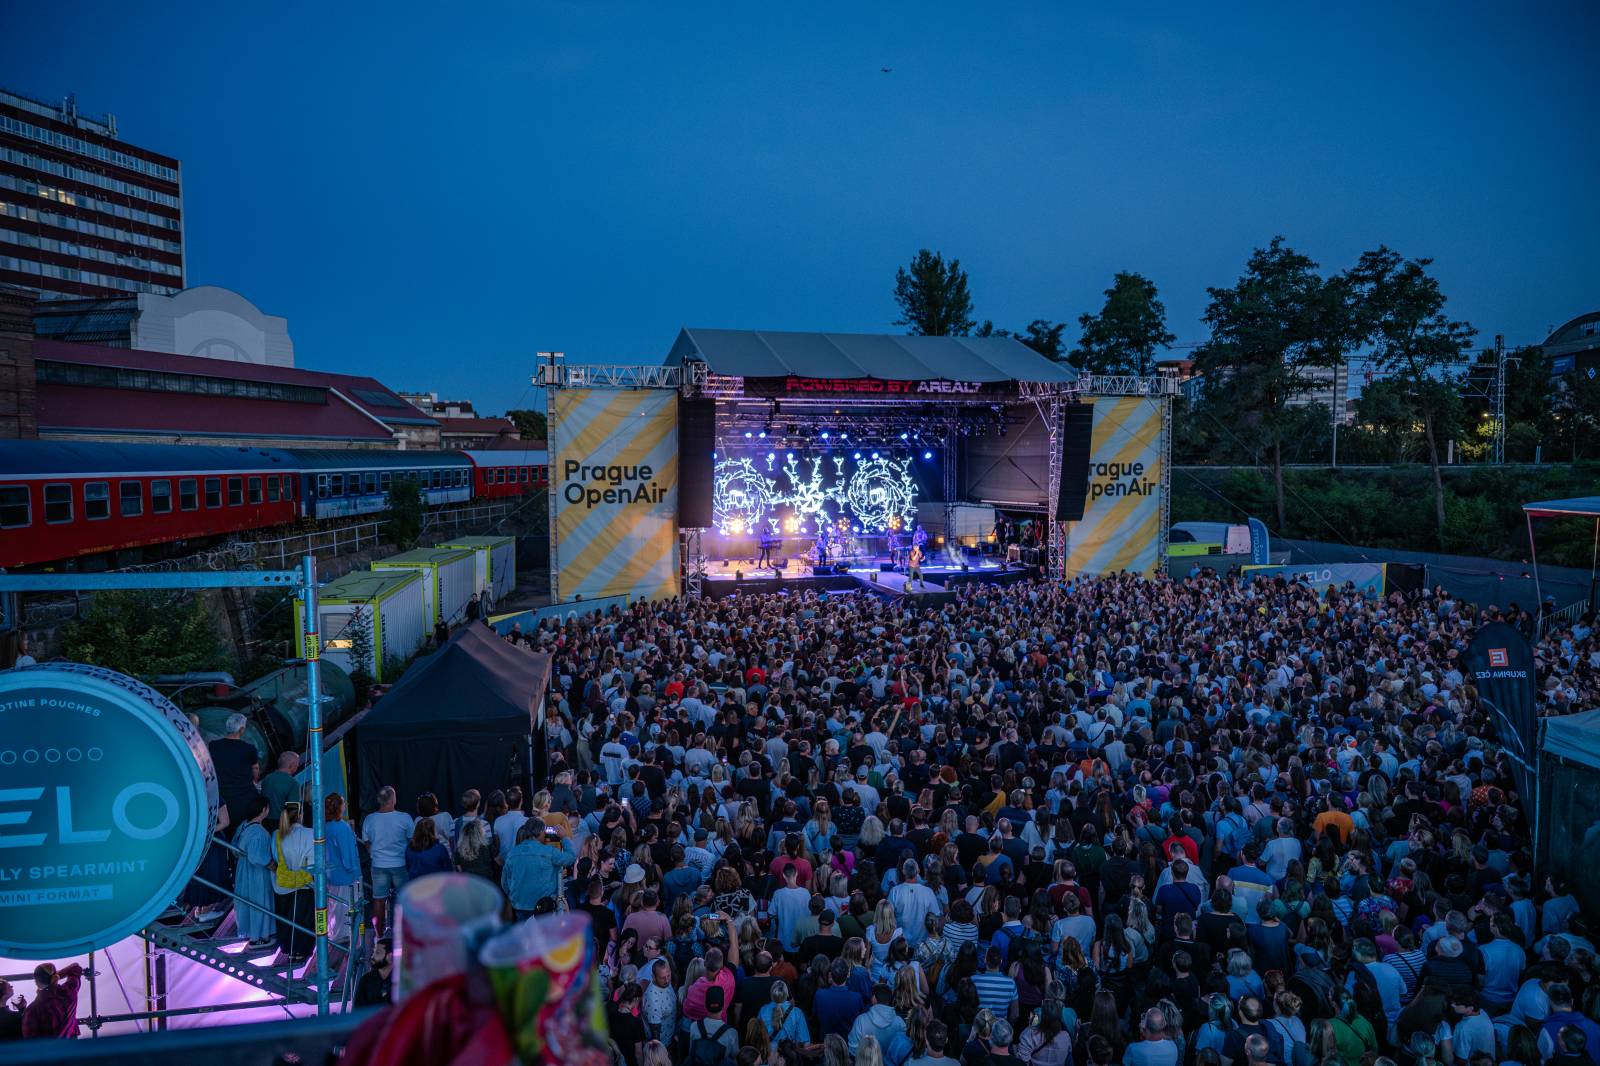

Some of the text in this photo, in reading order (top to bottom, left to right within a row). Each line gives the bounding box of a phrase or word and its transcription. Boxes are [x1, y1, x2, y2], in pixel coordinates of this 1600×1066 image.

[785, 378, 884, 392] POWERED
[887, 379, 912, 392] BY
[565, 460, 653, 486] Prague
[1087, 462, 1144, 480] rague
[564, 482, 667, 509] OpenAir
[1087, 477, 1155, 500] penAir
[1299, 569, 1332, 583] ELO
[41, 699, 101, 717] POUCHES
[30, 860, 148, 880] SPEARMINT
[38, 889, 99, 901] FORMAT
